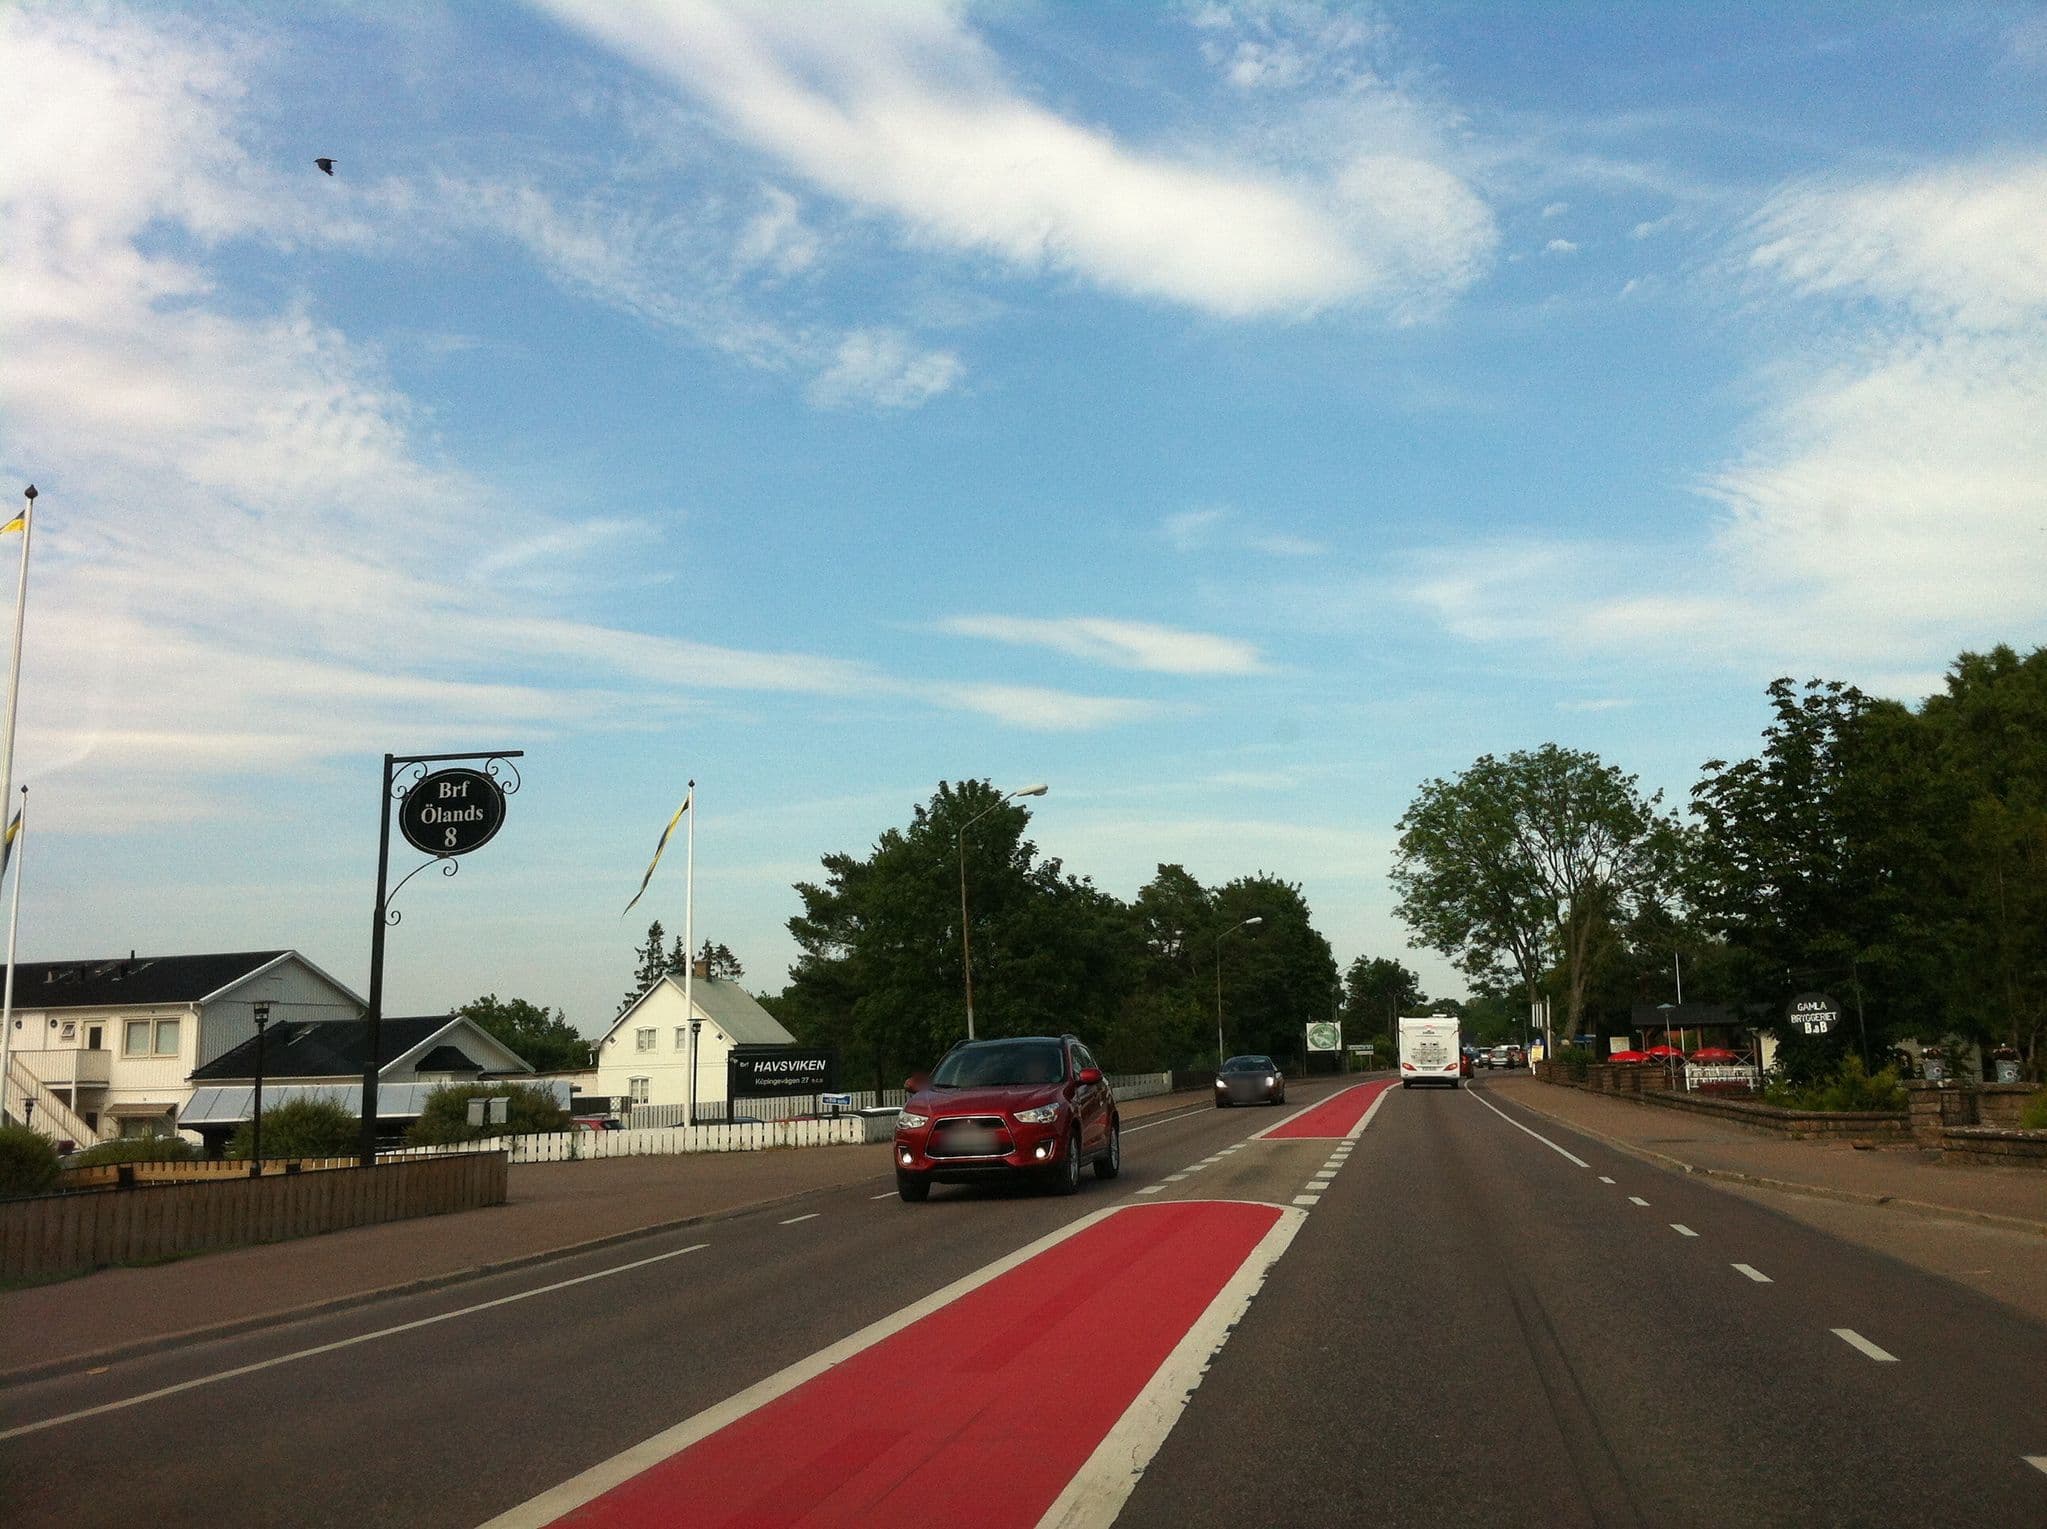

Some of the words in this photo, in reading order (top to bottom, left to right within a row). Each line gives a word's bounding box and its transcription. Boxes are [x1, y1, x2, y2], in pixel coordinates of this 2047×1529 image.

[438, 780, 471, 799] Brf
[420, 803, 484, 825] Ölands
[444, 826, 458, 847] 8
[1797, 1001, 1828, 1012] GAMLA
[753, 1059, 826, 1073] HAVSVIKEN
[801, 1076, 809, 1084] 27
